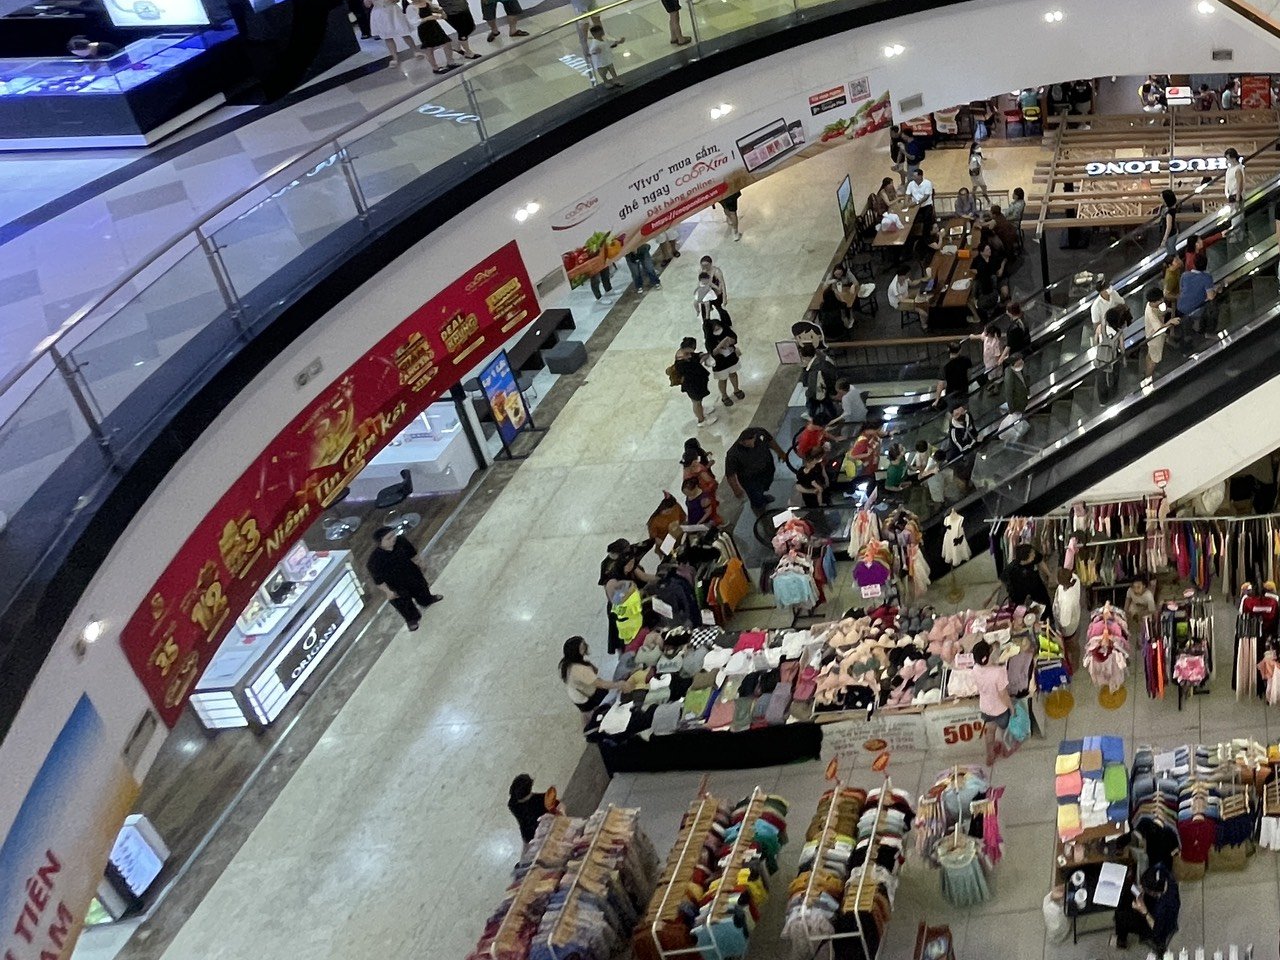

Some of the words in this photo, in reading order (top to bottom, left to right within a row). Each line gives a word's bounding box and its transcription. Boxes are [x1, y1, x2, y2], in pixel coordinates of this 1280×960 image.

[668, 157, 692, 175] mua
[1085, 160, 1161, 176] LONG
[1168, 156, 1245, 173] HUC
[642, 184, 671, 205] ngay
[291, 623, 337, 679] ORIGANI
[943, 720, 988, 745] 50%
